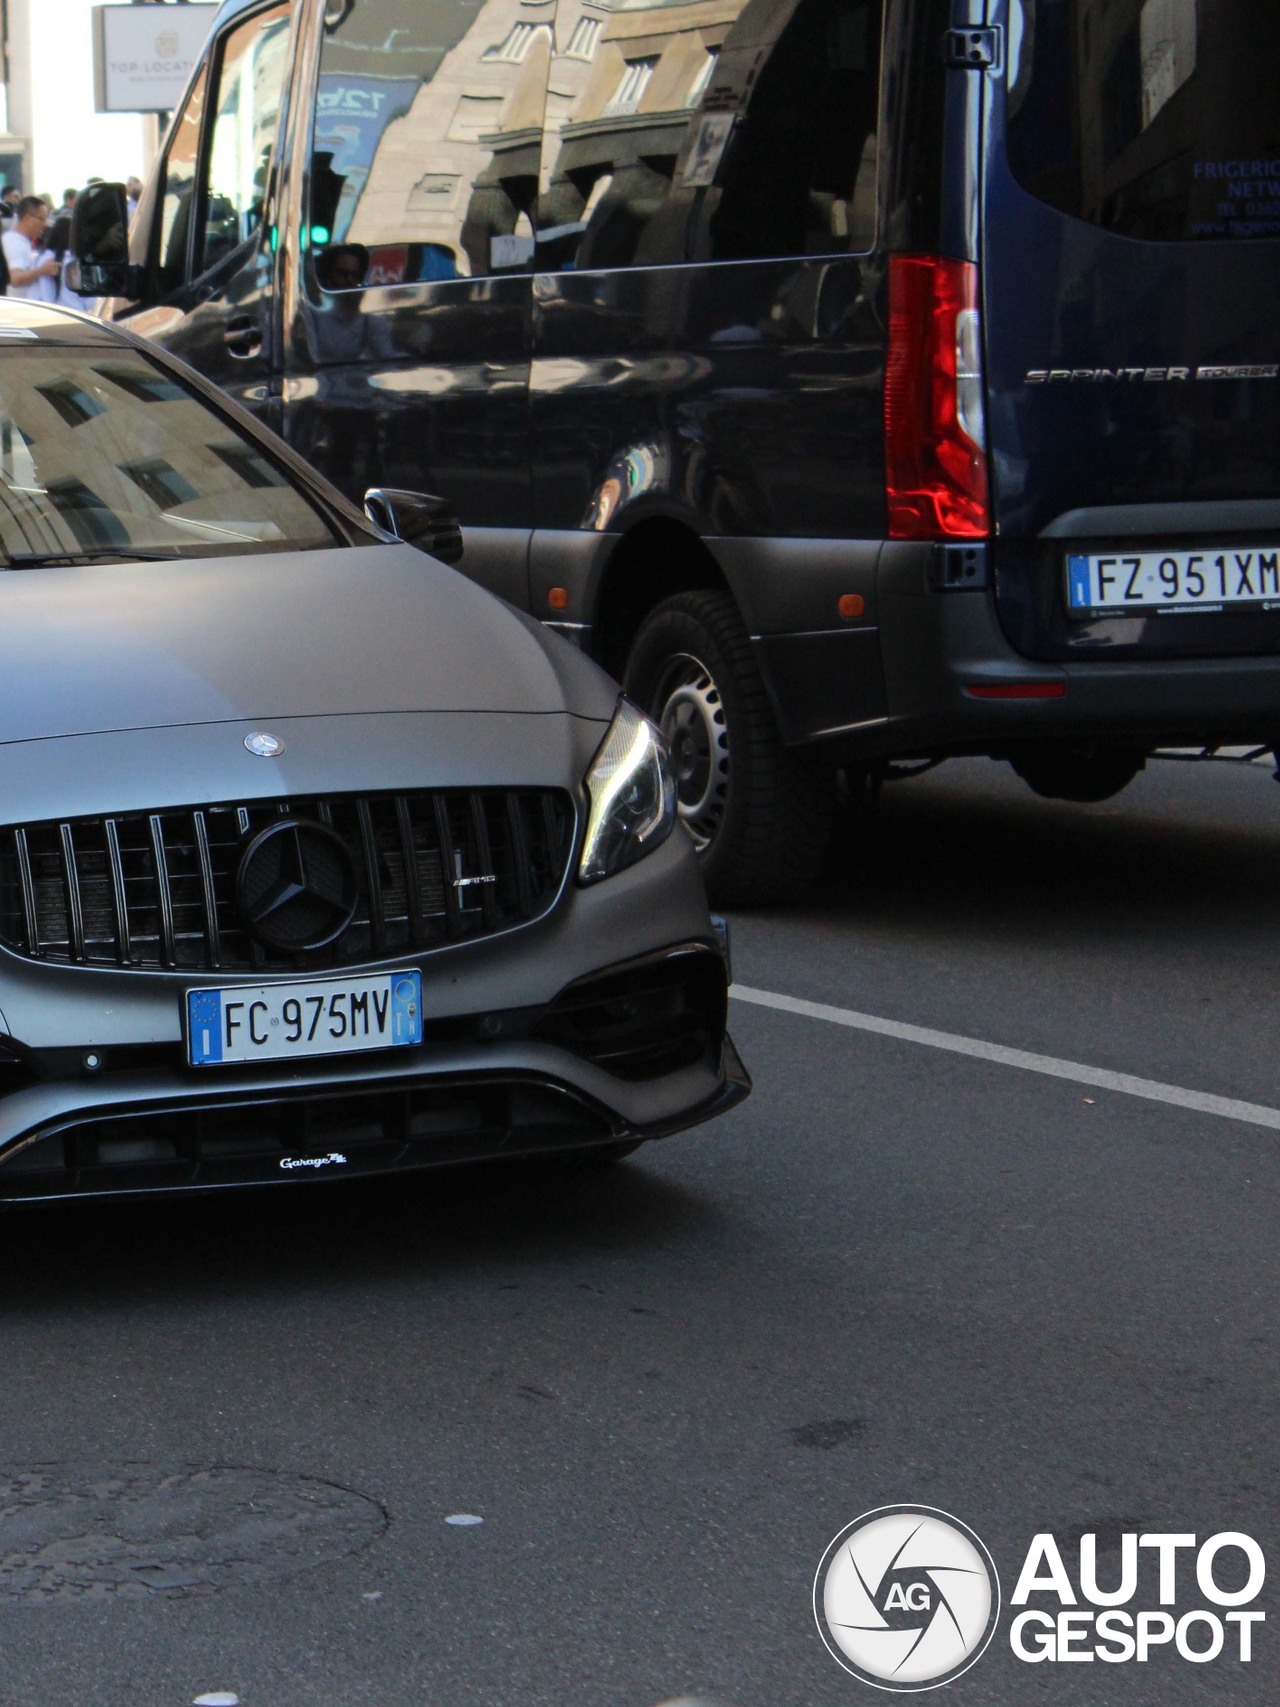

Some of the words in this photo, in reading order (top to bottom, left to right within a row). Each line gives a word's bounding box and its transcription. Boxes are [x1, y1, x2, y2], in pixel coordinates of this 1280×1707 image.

[110, 62, 138, 73] TOP
[1024, 367, 1190, 384] SPRINTER
[1098, 558, 1143, 600] FZ
[1158, 552, 1280, 598] 951XM
[225, 1001, 268, 1047] FC
[282, 988, 389, 1042] 975MV
[280, 1157, 330, 1168] Garage
